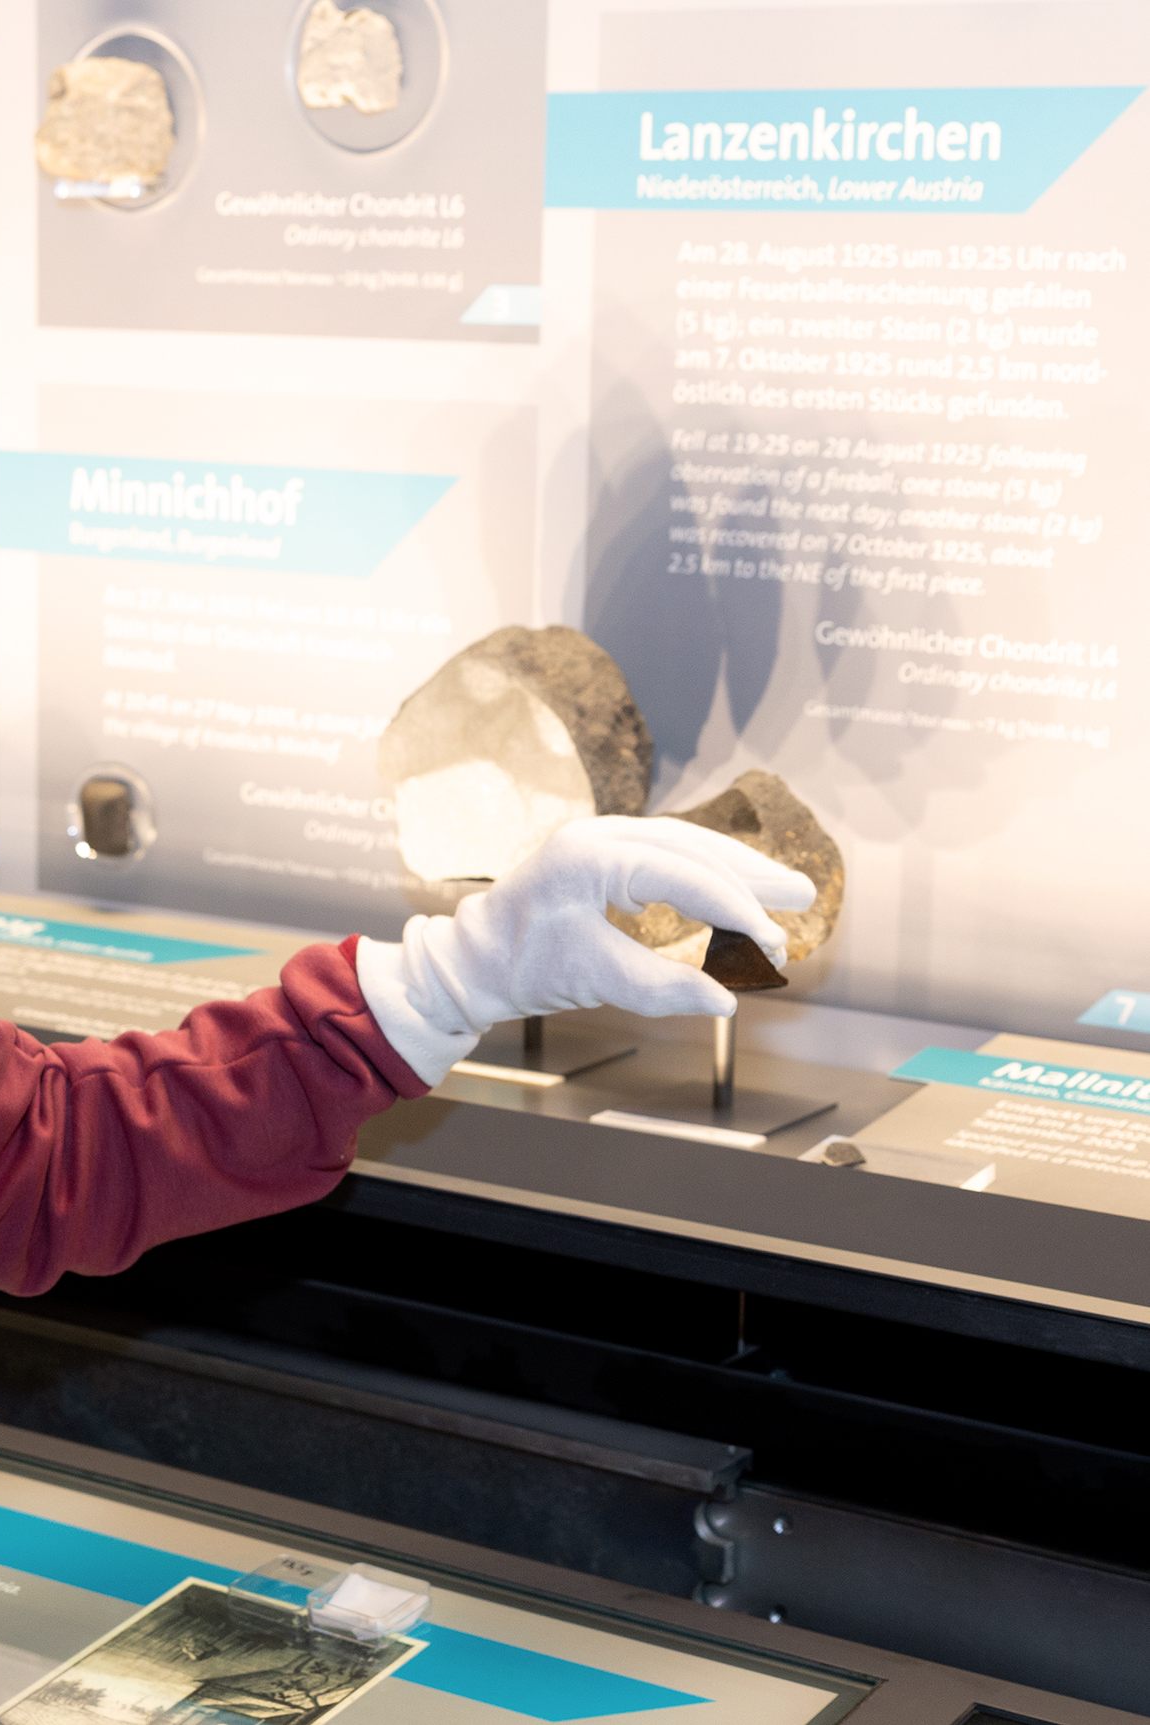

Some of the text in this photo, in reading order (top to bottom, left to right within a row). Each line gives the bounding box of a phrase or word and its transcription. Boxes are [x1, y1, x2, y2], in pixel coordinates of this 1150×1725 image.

[641, 107, 1001, 160] Lanzenkirchen
[350, 192, 436, 218] Chondrit
[636, 175, 983, 203] Niederösterreich, Lower Austria
[676, 241, 715, 264] Am
[756, 242, 836, 273] August
[841, 243, 898, 269] 1925
[903, 248, 941, 270] um
[1017, 247, 1066, 272] Uhr
[1067, 246, 1127, 272] nach
[676, 276, 734, 300] einer
[993, 281, 1091, 314] gefallen
[749, 312, 784, 337] ein
[789, 314, 874, 339] zweiter
[881, 316, 940, 342] Stein
[1018, 320, 1099, 347] wurde
[677, 349, 710, 370] am
[739, 346, 829, 375] Oktober
[834, 350, 892, 377] 1925
[897, 353, 948, 380] rund
[999, 355, 1037, 382] km
[673, 379, 745, 406] östlich
[749, 380, 788, 408] des
[792, 386, 865, 411] ersten
[868, 386, 944, 415] Stücks
[671, 429, 704, 452] Fell
[705, 433, 728, 453] at
[792, 439, 819, 457] on
[822, 436, 850, 459] 28
[852, 438, 924, 468] August
[930, 442, 982, 466] 1925
[981, 443, 1088, 478] following
[69, 466, 305, 527] Minnichhof
[670, 461, 780, 487] observation
[782, 466, 807, 495] of
[807, 471, 822, 489] a
[902, 476, 940, 497] one
[945, 475, 1001, 500] stone
[670, 495, 707, 515] was
[707, 492, 768, 520] found
[770, 497, 803, 520] the
[805, 500, 849, 523] next
[899, 505, 982, 530] another
[982, 510, 1040, 534] stone
[708, 529, 800, 552] recovered
[801, 537, 828, 553] on
[832, 532, 847, 555] 7
[848, 533, 927, 559] October
[990, 543, 1054, 569] about
[702, 553, 730, 576] km
[733, 558, 757, 579] to
[758, 558, 792, 582] the
[793, 562, 824, 585] NE
[824, 563, 850, 592] of
[850, 565, 882, 591] the
[881, 566, 927, 595] first
[815, 620, 1119, 669] Gewöhnlicher Chondrit L4
[899, 661, 988, 694] Ordinary
[989, 669, 1089, 700] chondrite
[1115, 995, 1137, 1025] 7
